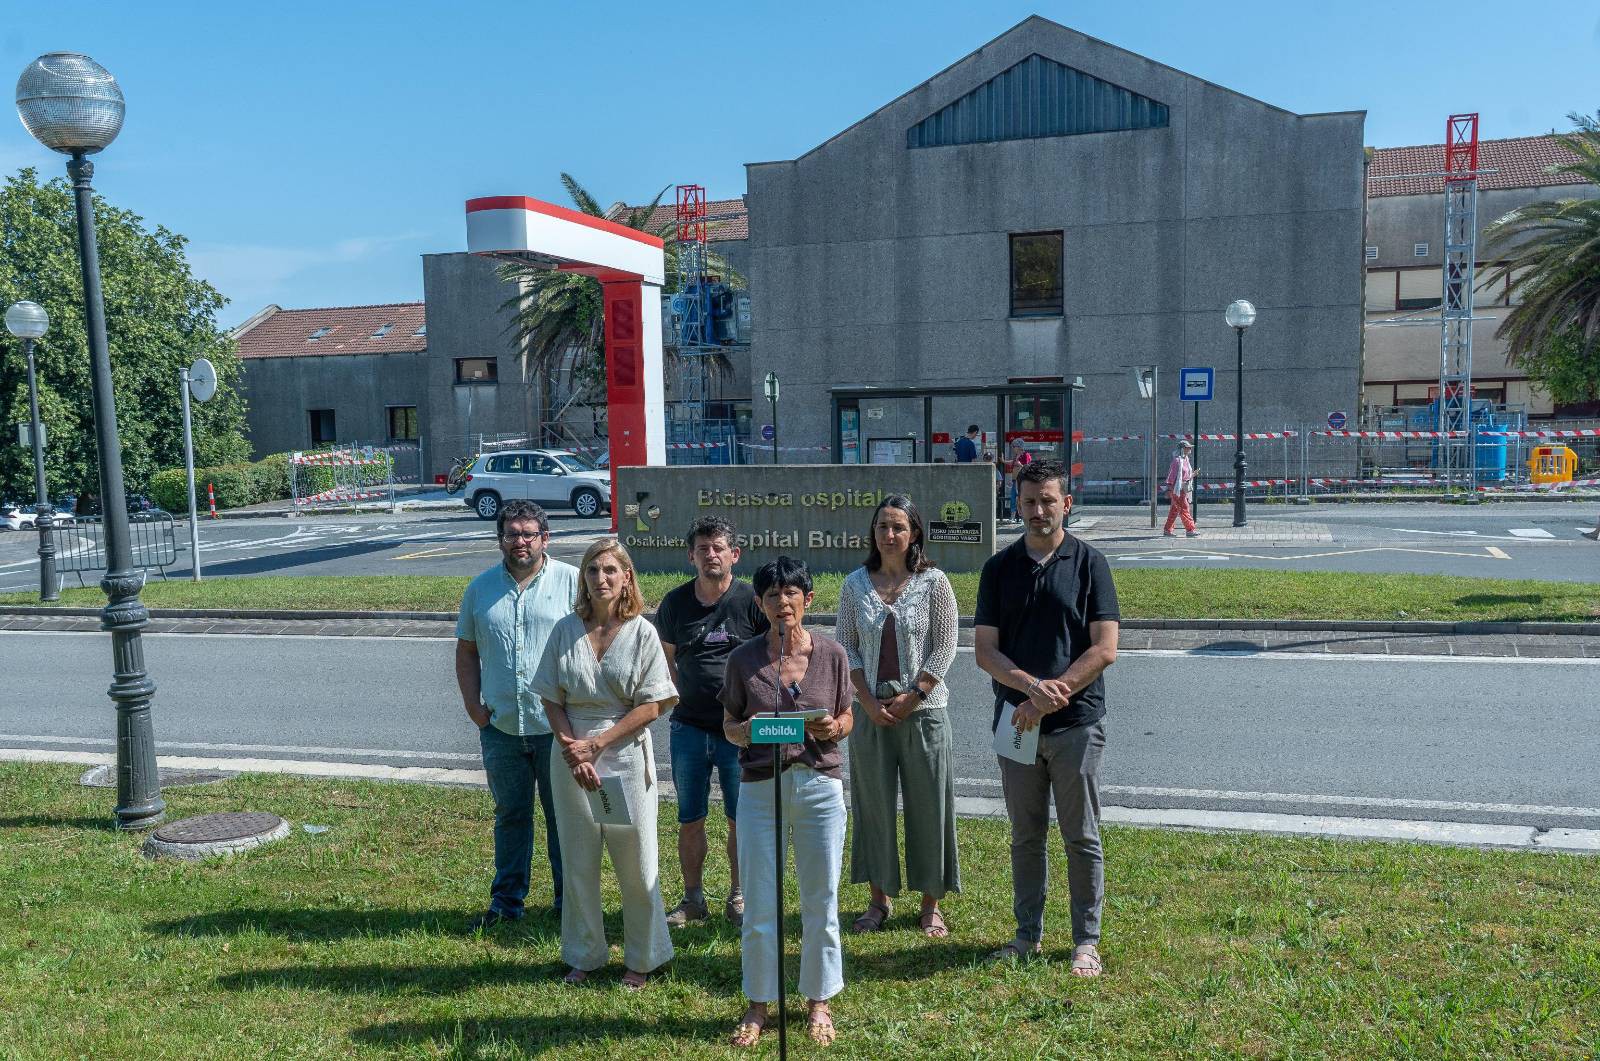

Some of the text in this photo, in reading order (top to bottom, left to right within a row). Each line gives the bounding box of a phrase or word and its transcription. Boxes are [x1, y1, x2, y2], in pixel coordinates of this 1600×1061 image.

[697, 488, 911, 511] Bidasoa ospital
[626, 535, 688, 548] Osakidetz
[736, 529, 871, 551] spital Bidas
[758, 725, 797, 736] ehbildu
